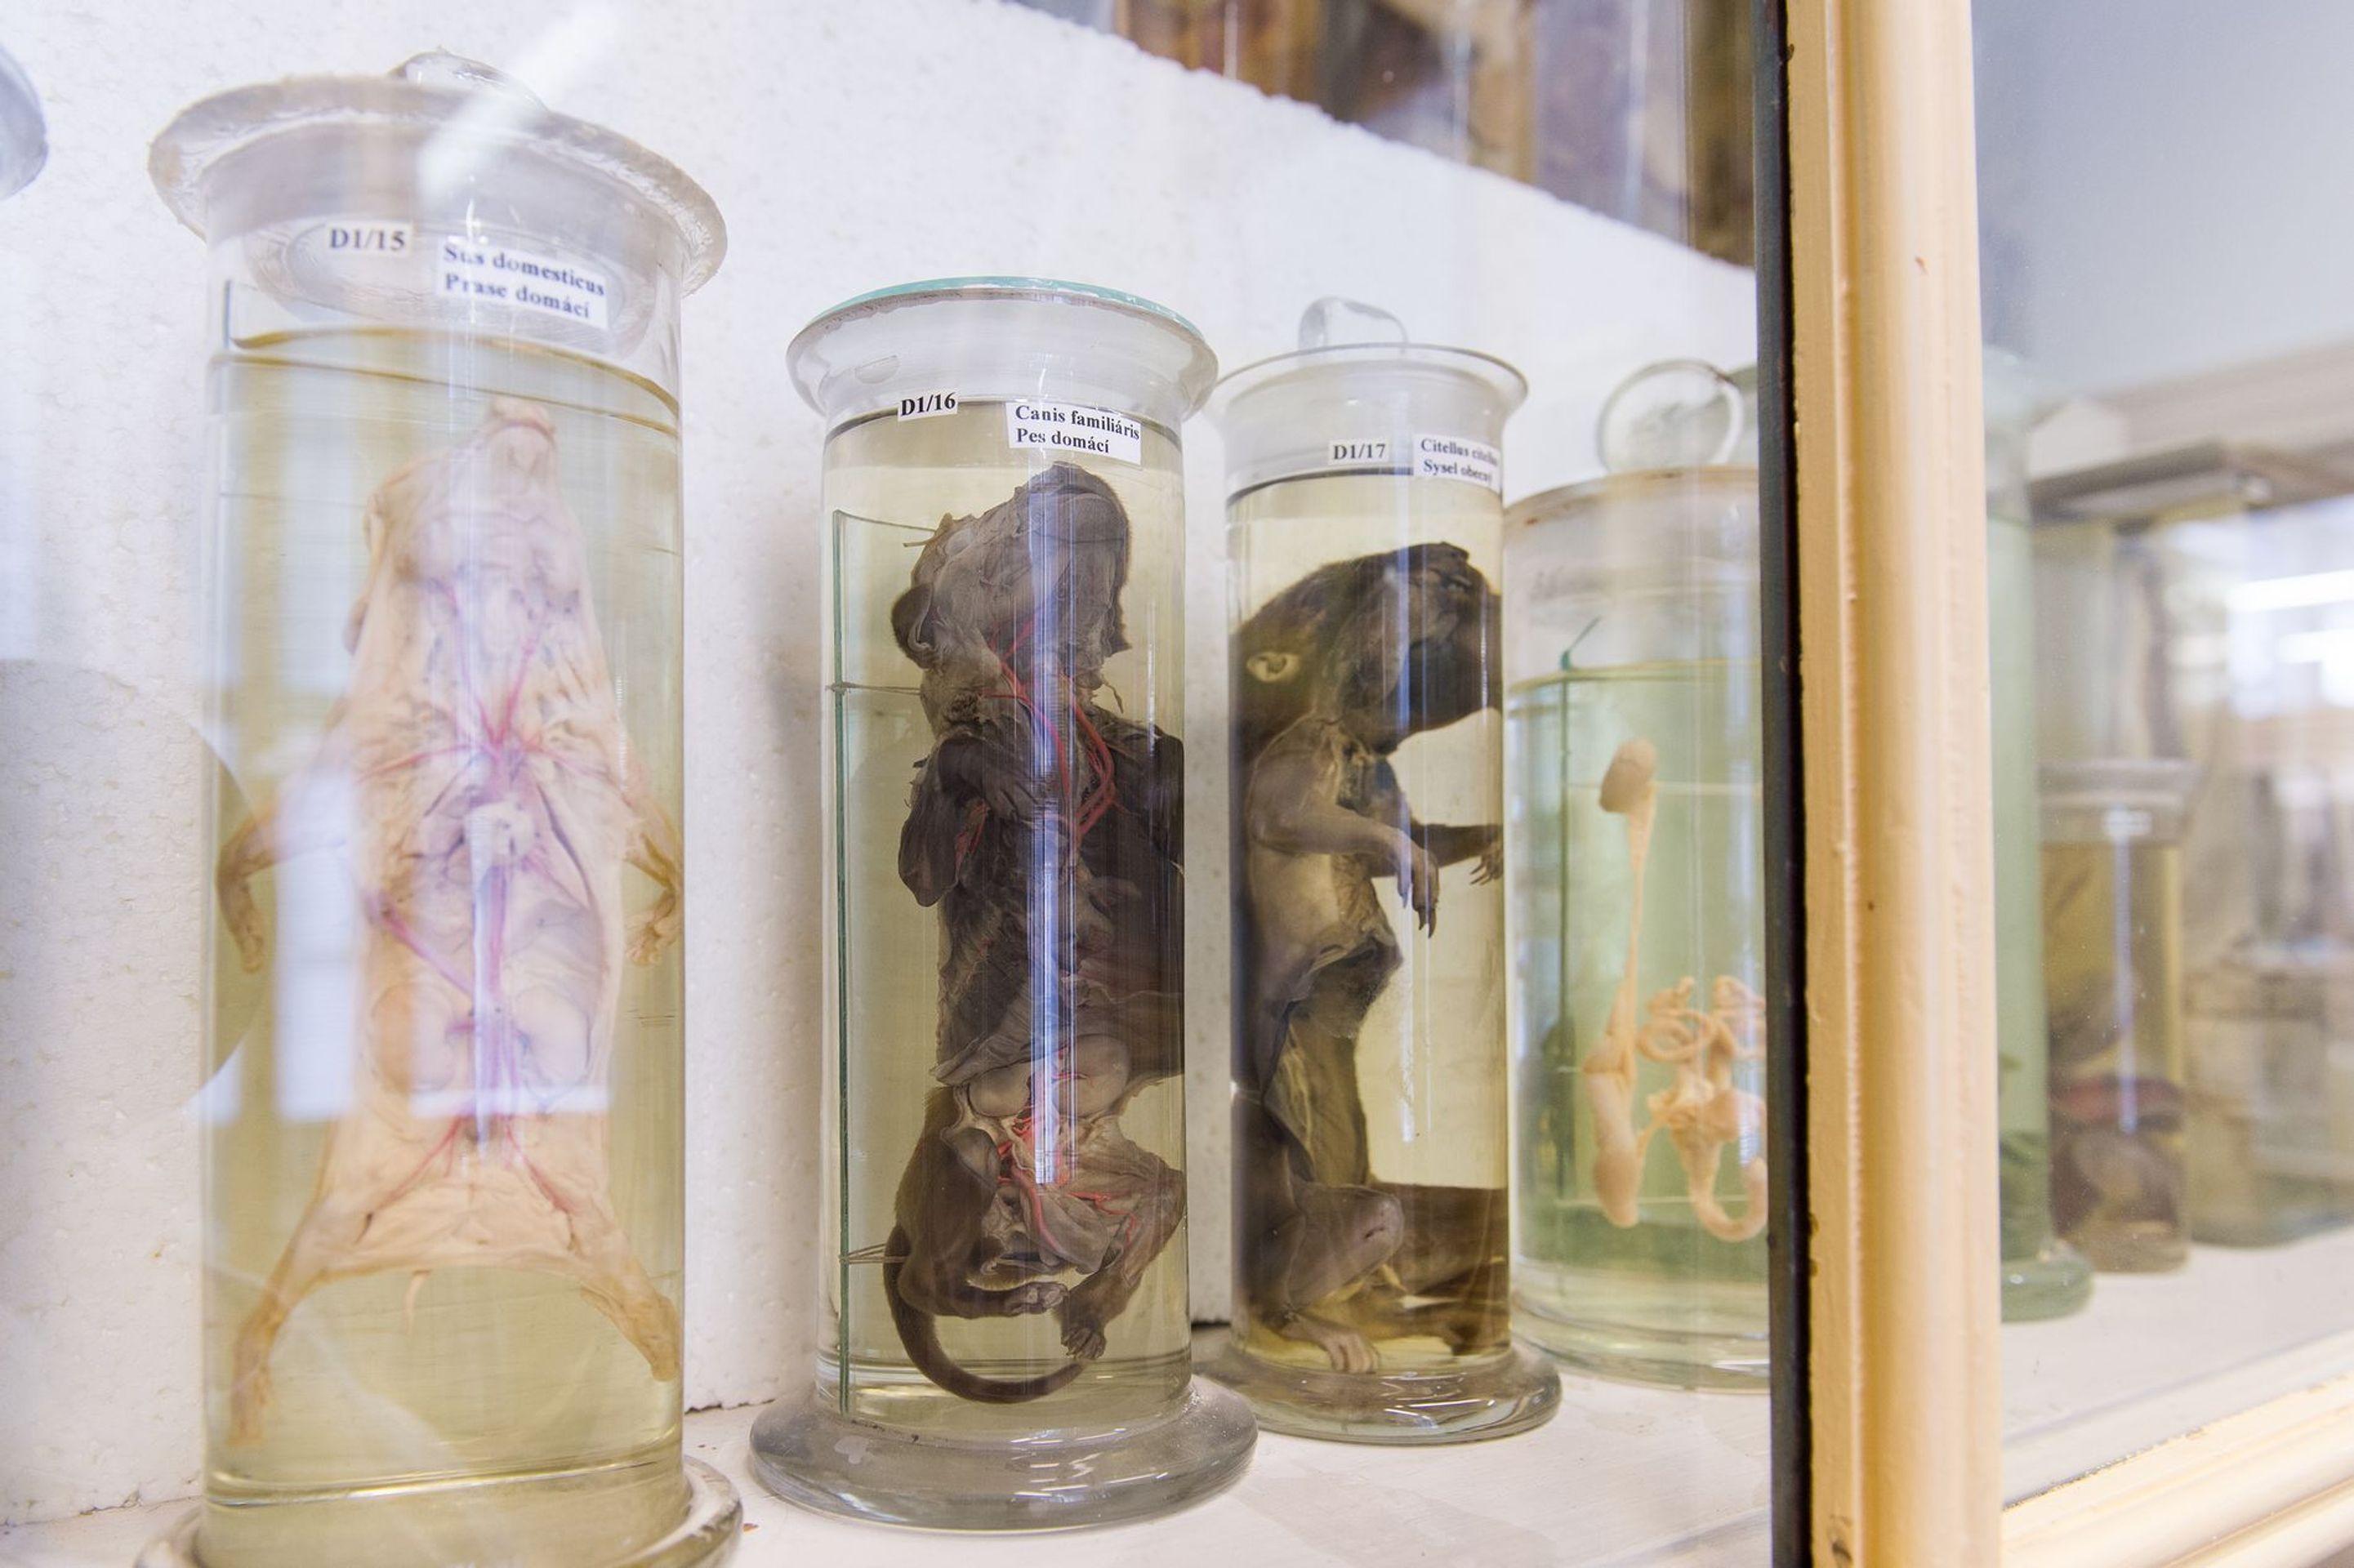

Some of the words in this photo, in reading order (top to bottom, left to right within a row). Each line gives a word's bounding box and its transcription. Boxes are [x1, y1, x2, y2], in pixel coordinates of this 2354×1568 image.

[330, 228, 407, 251] D1/15
[492, 252, 605, 296] domesticus
[445, 272, 508, 297] Prase
[515, 286, 591, 318] domácí
[901, 392, 956, 416] D1/16
[1015, 405, 1066, 422] Canis
[1071, 410, 1140, 440] familiáris
[1017, 428, 1046, 443] Pes
[1051, 431, 1109, 453] domácí
[1333, 444, 1386, 460] D1/17
[1420, 438, 1469, 457] Citellus
[1424, 459, 1458, 475] Sysel
